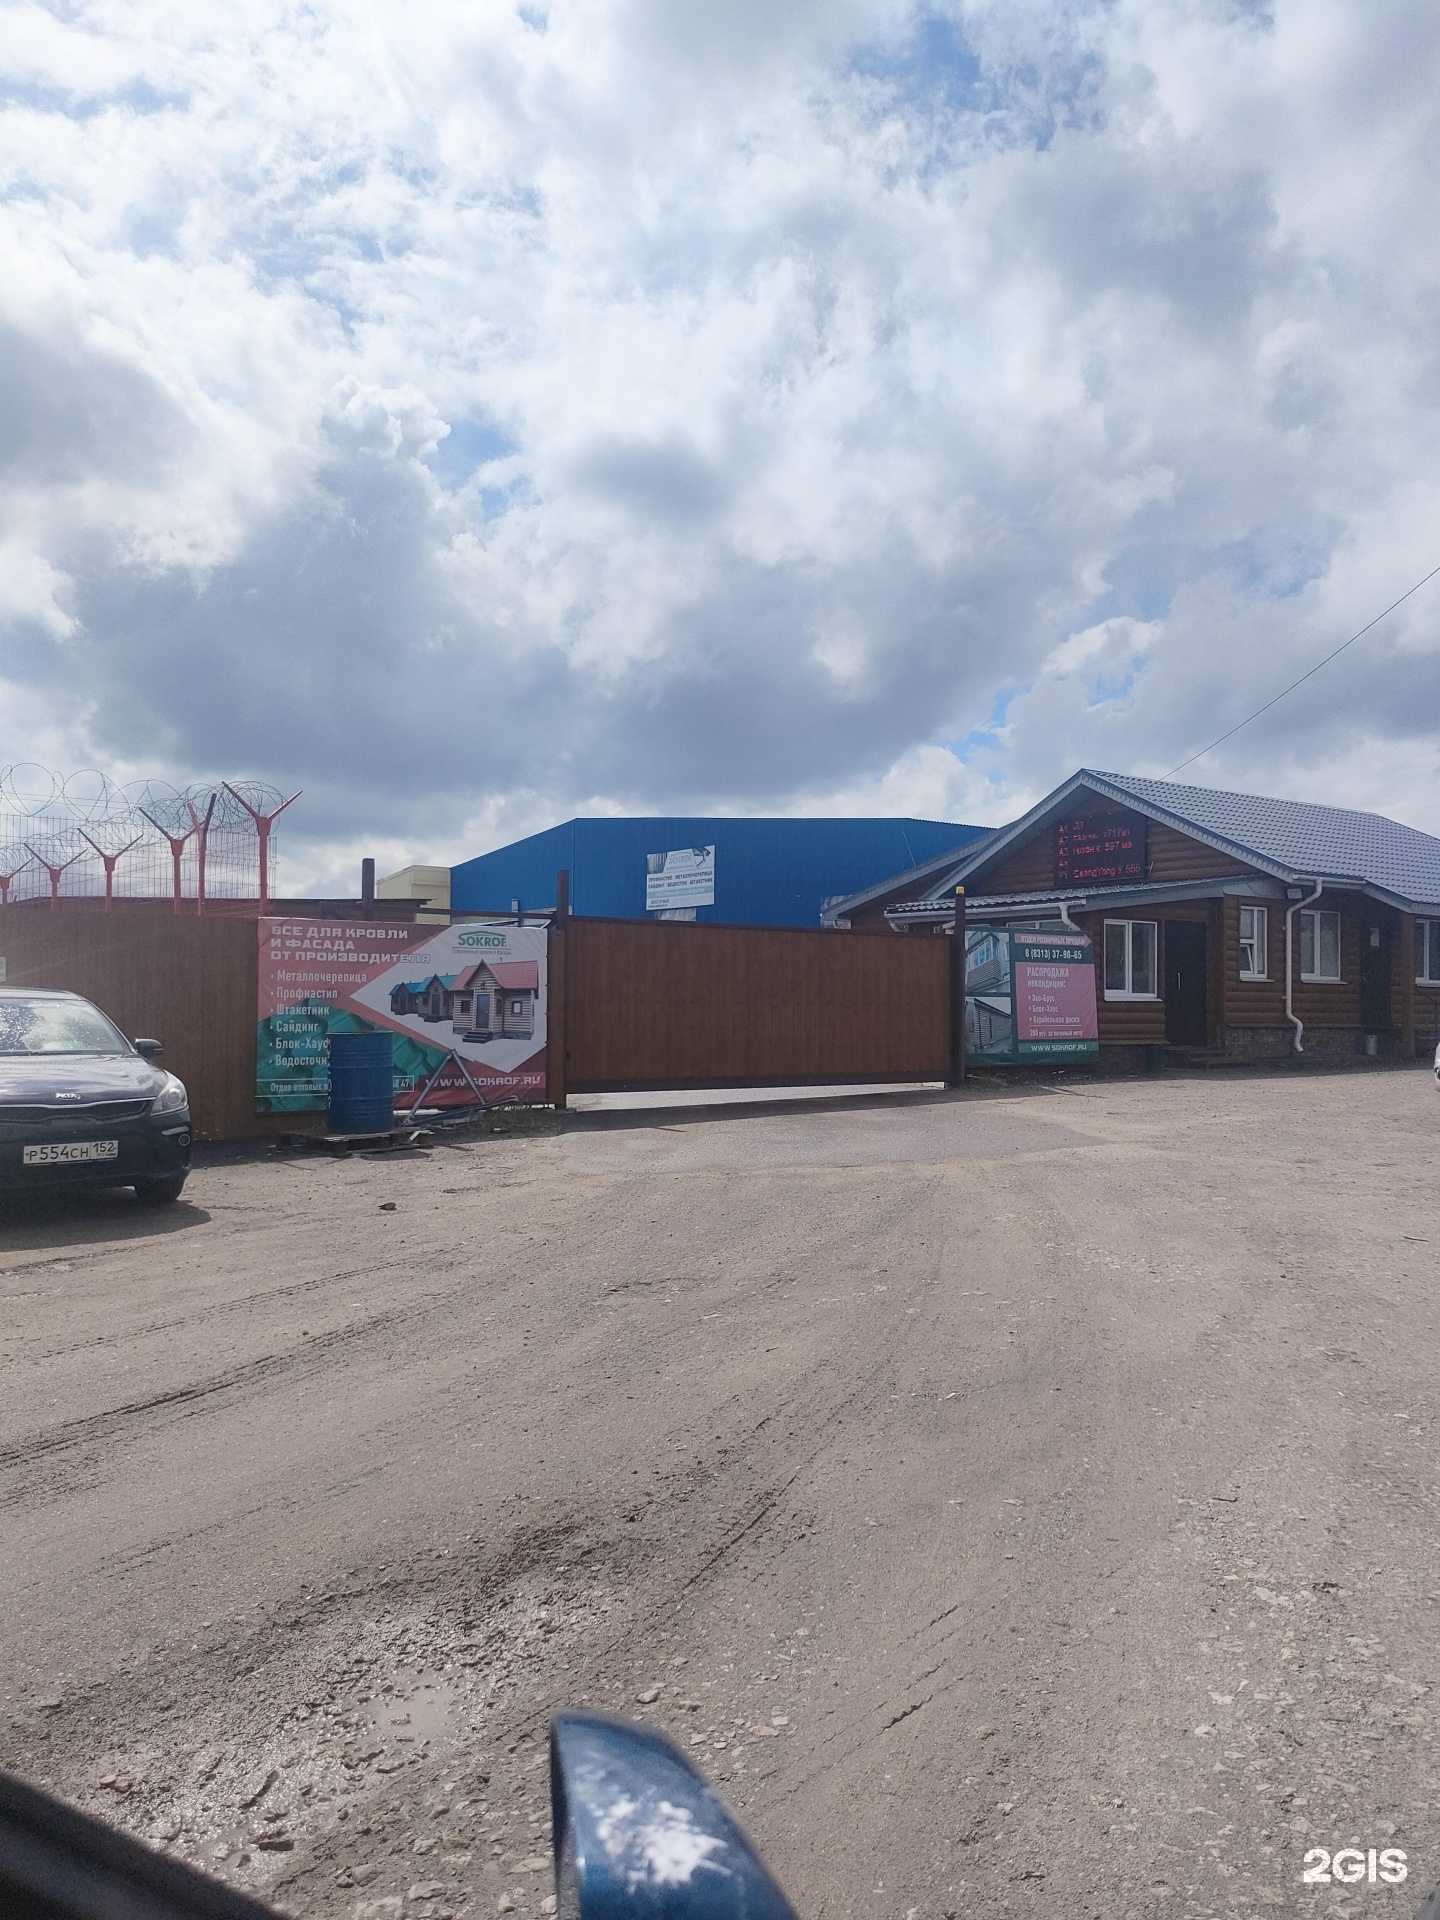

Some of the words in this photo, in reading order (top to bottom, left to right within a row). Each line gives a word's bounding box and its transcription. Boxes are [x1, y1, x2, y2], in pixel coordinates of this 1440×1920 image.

[271, 926, 303, 936] ВСЕ
[306, 927, 342, 938] ДЛЯ
[345, 928, 408, 939] КРОВЛИ
[458, 931, 507, 947] SOKROF
[270, 939, 281, 948] И
[286, 939, 355, 951] ФАСАДА
[270, 951, 292, 961] ОТ
[295, 952, 432, 964] ПРОИЗВОДИТЕЛЯ
[276, 969, 368, 984] Металлочерепица
[276, 987, 338, 1000] Профнастил
[276, 1004, 330, 1015] Штакетник
[276, 1019, 319, 1033] Сайдинг
[93, 1142, 114, 1153] 152
